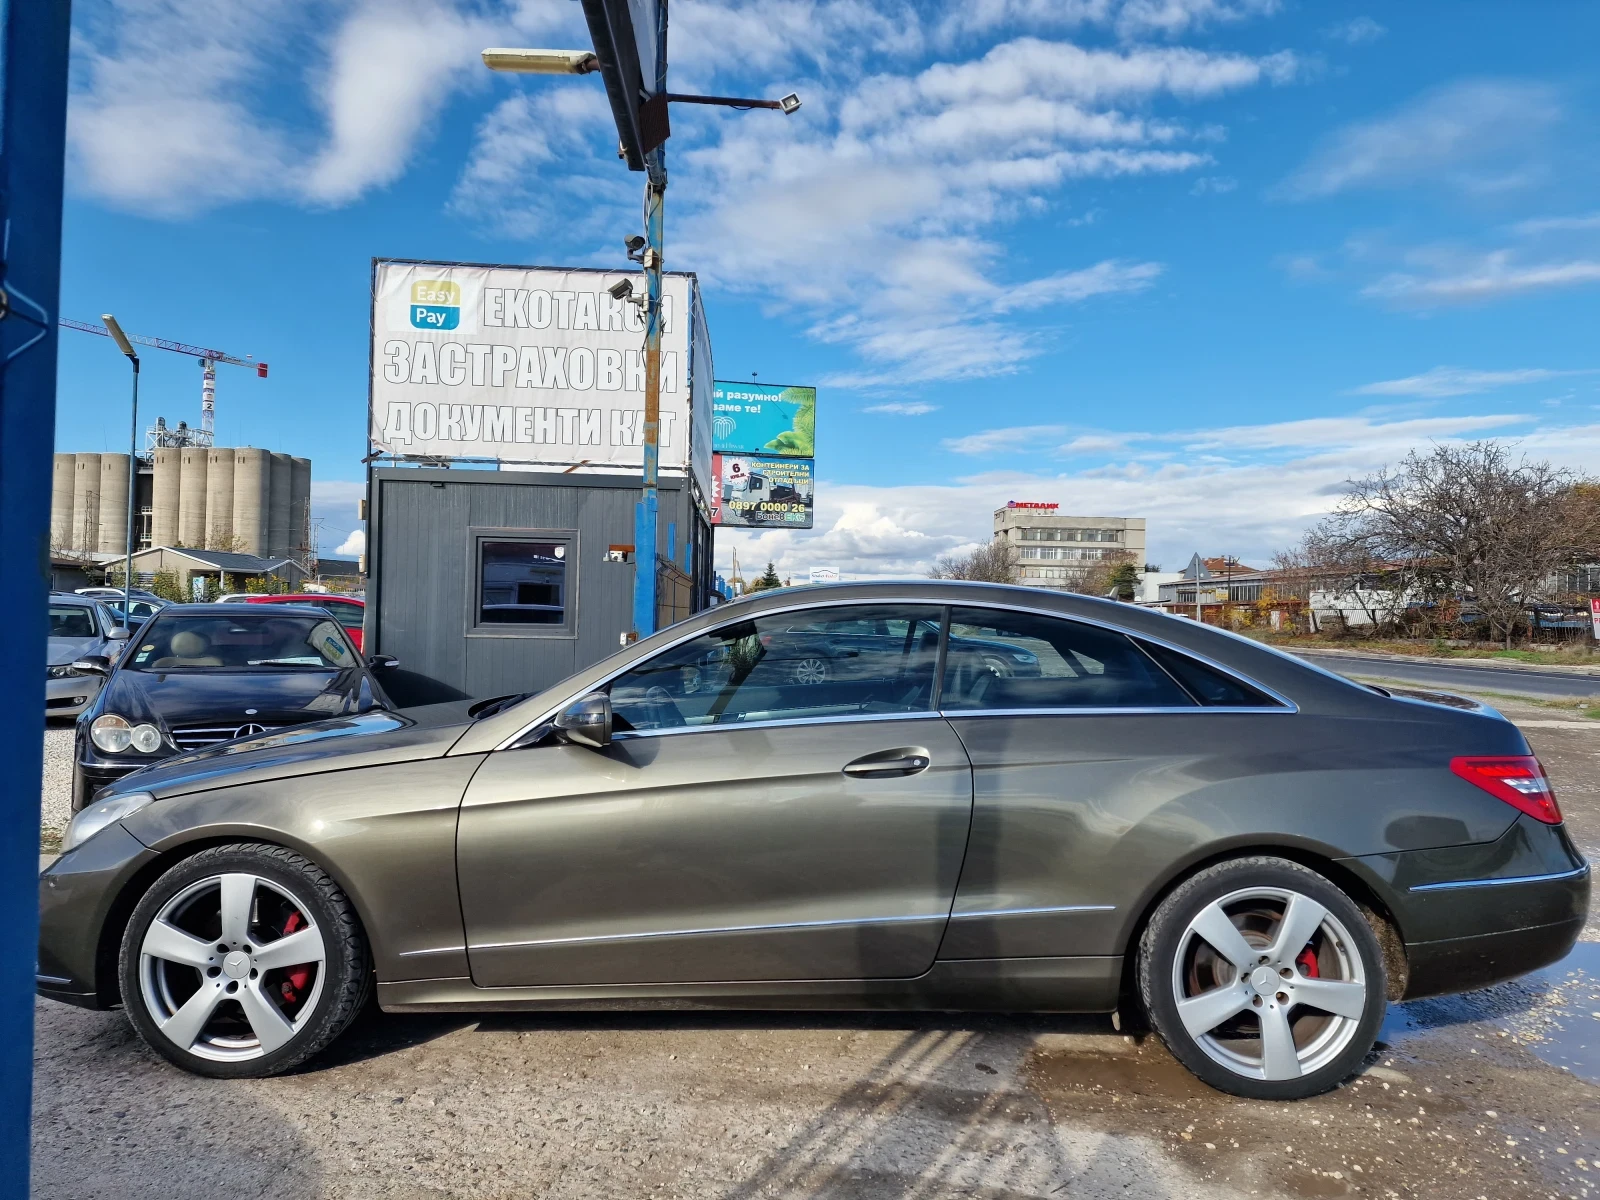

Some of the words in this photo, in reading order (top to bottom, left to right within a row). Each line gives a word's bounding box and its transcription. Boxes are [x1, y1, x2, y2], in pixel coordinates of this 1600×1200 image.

[416, 286, 455, 303] Easy
[416, 307, 446, 327] Pay
[383, 339, 677, 393] ЗАСТРАХОВКИ
[727, 391, 782, 402] разумно!
[745, 404, 761, 413] те!
[383, 401, 601, 446] ДОКУМЕНТИ
[732, 463, 741, 473] 6
[729, 500, 756, 510] 0897
[760, 502, 788, 512] 0000
[791, 504, 805, 512] 26
